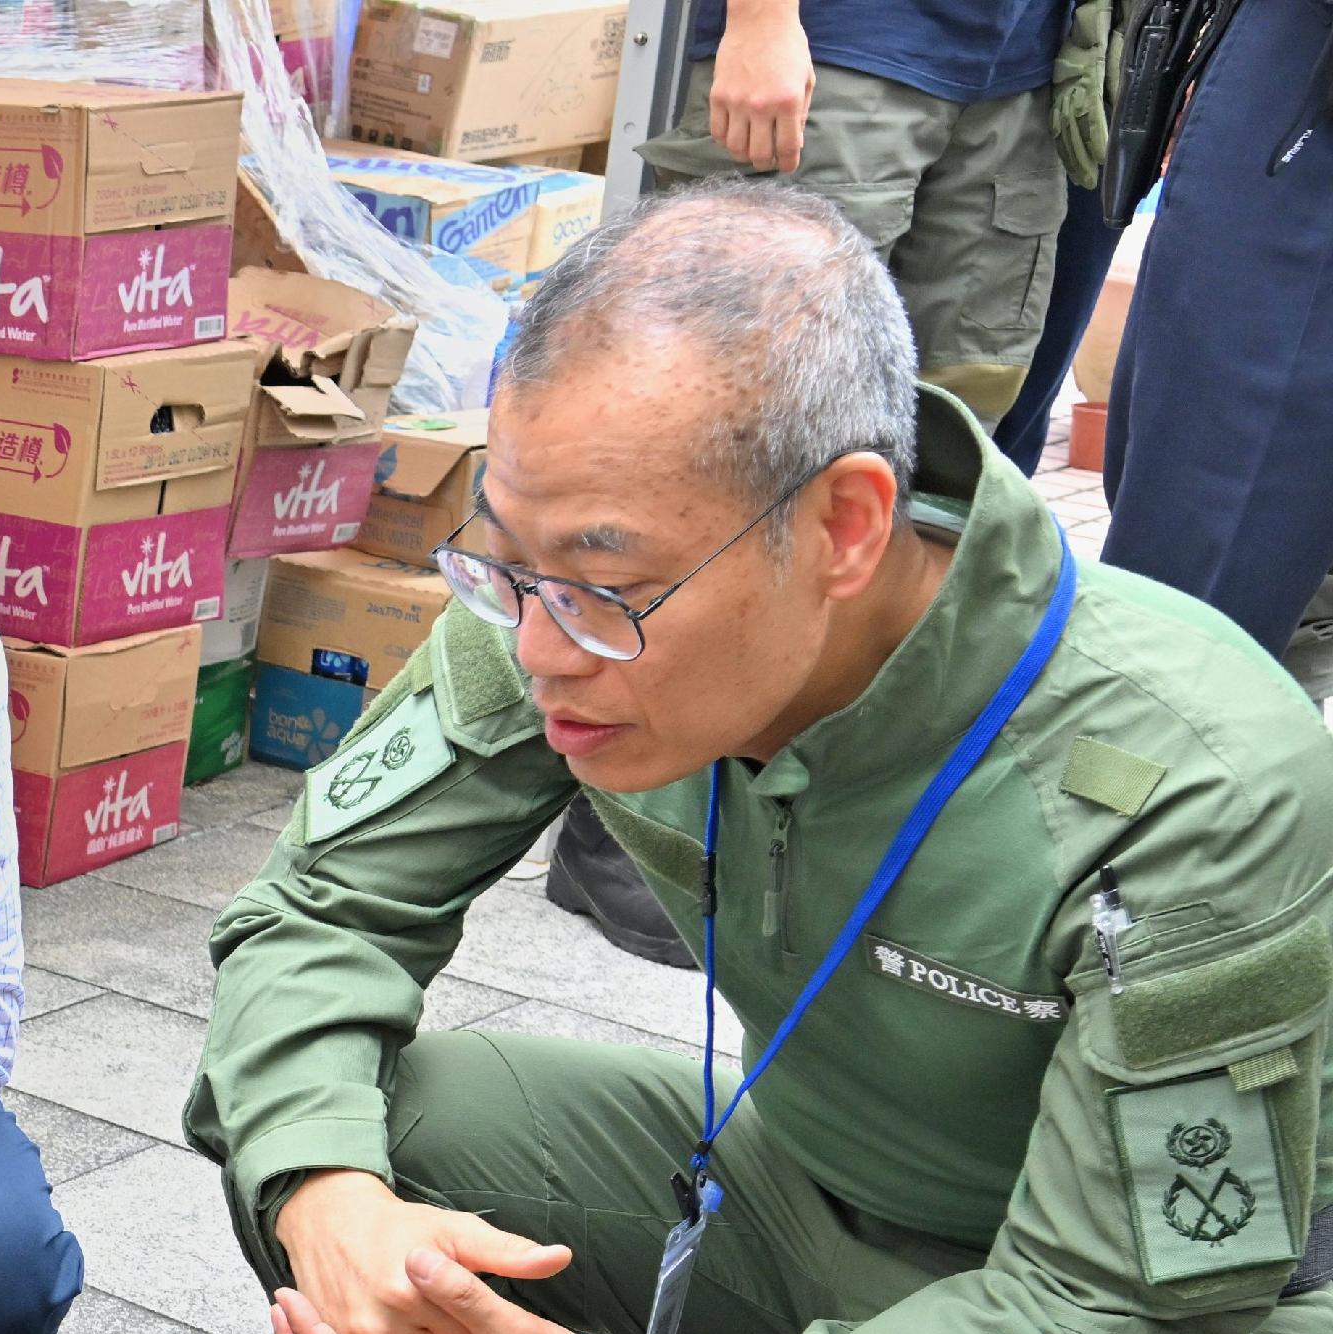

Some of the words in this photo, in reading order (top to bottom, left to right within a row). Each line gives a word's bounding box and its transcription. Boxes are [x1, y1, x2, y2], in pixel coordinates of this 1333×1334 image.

[118, 243, 194, 314] vita
[7, 326, 37, 342] Water
[273, 460, 337, 520] vita
[121, 531, 193, 598] vita
[389, 531, 423, 550] WATER
[268, 707, 299, 730] bon
[84, 769, 151, 835] vita
[908, 958, 1022, 1015] POLICE
